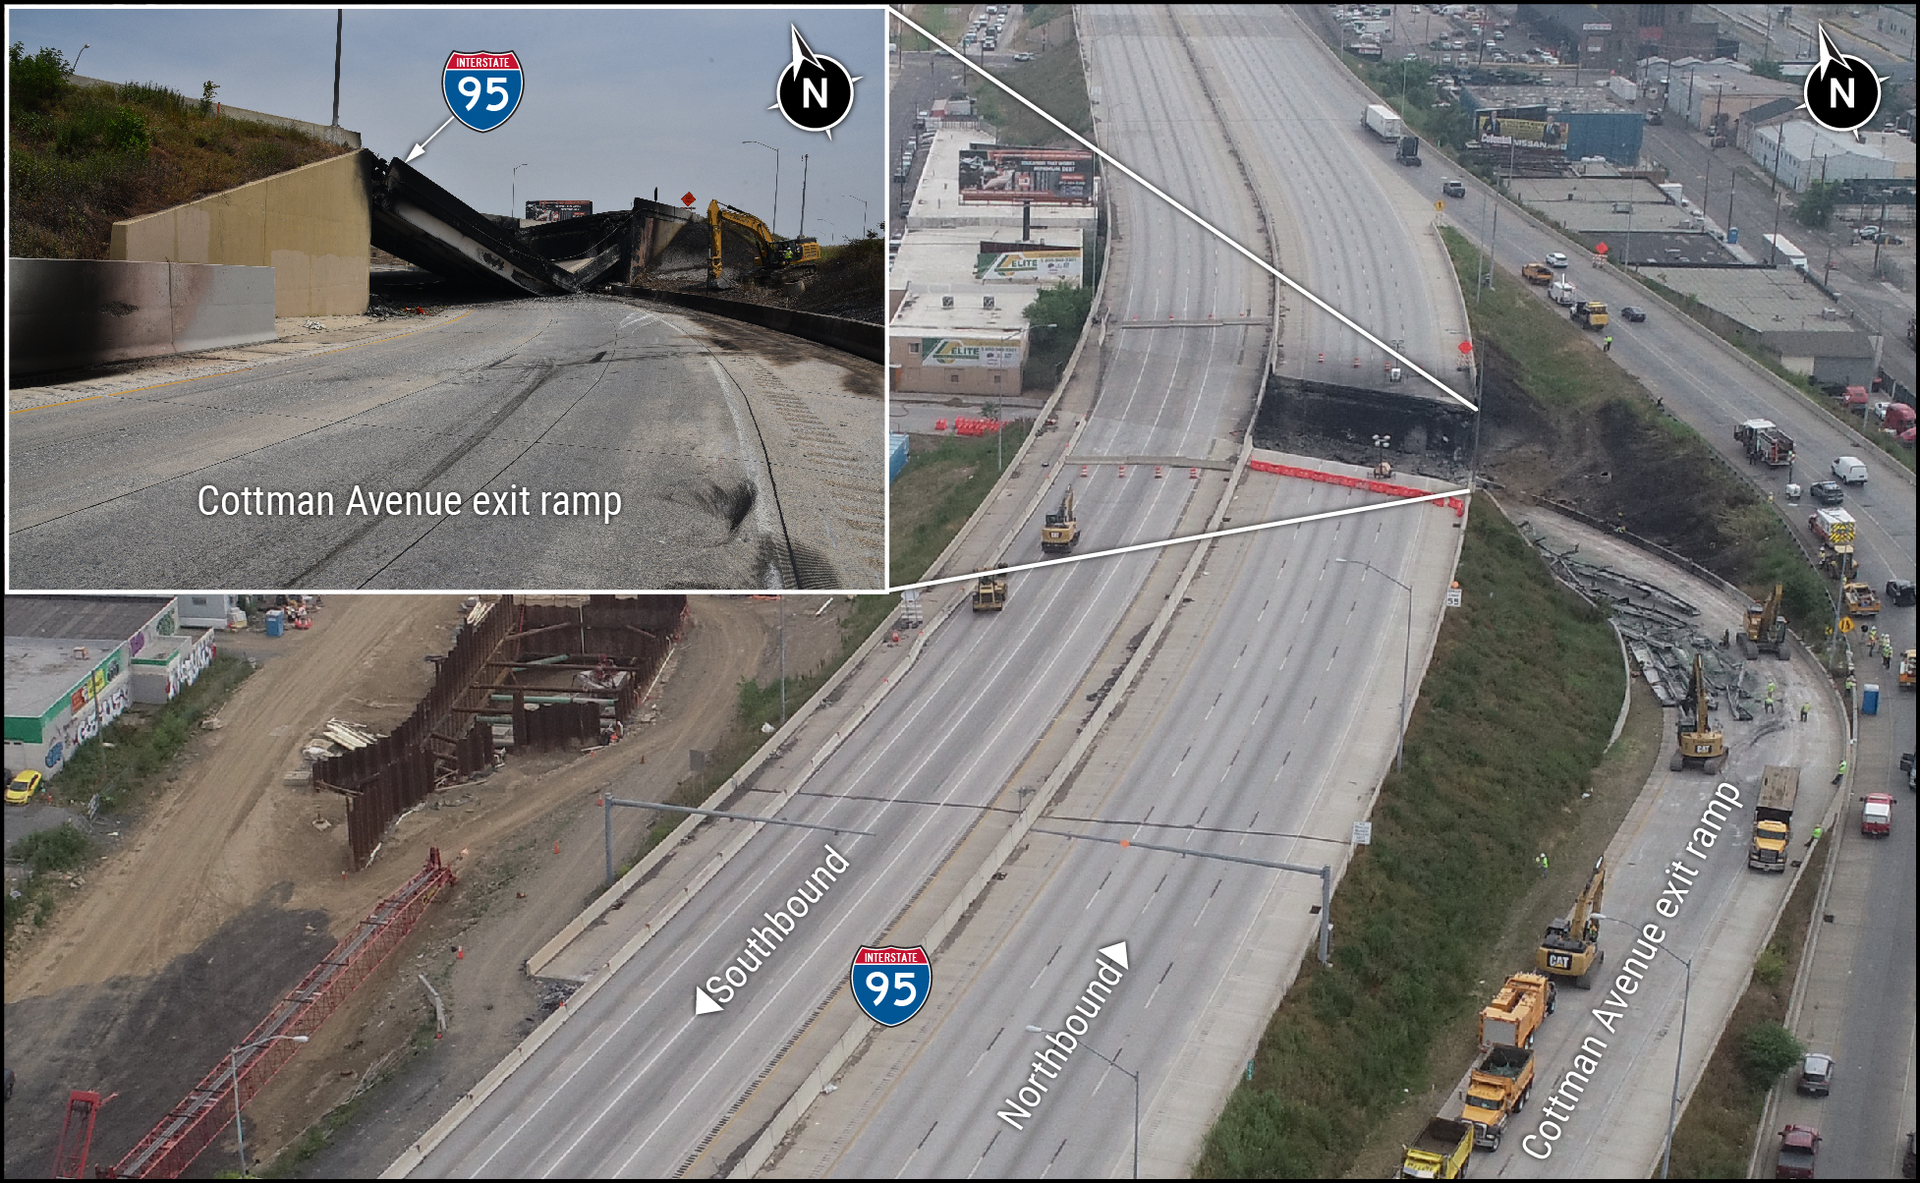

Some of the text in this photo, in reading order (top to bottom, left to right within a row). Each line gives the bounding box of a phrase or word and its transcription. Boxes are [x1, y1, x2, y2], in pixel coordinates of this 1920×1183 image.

[1011, 259, 1038, 267] ELITE
[950, 347, 980, 355] ELITE
[1696, 745, 1710, 753] CAT
[1549, 954, 1570, 968] CAT
